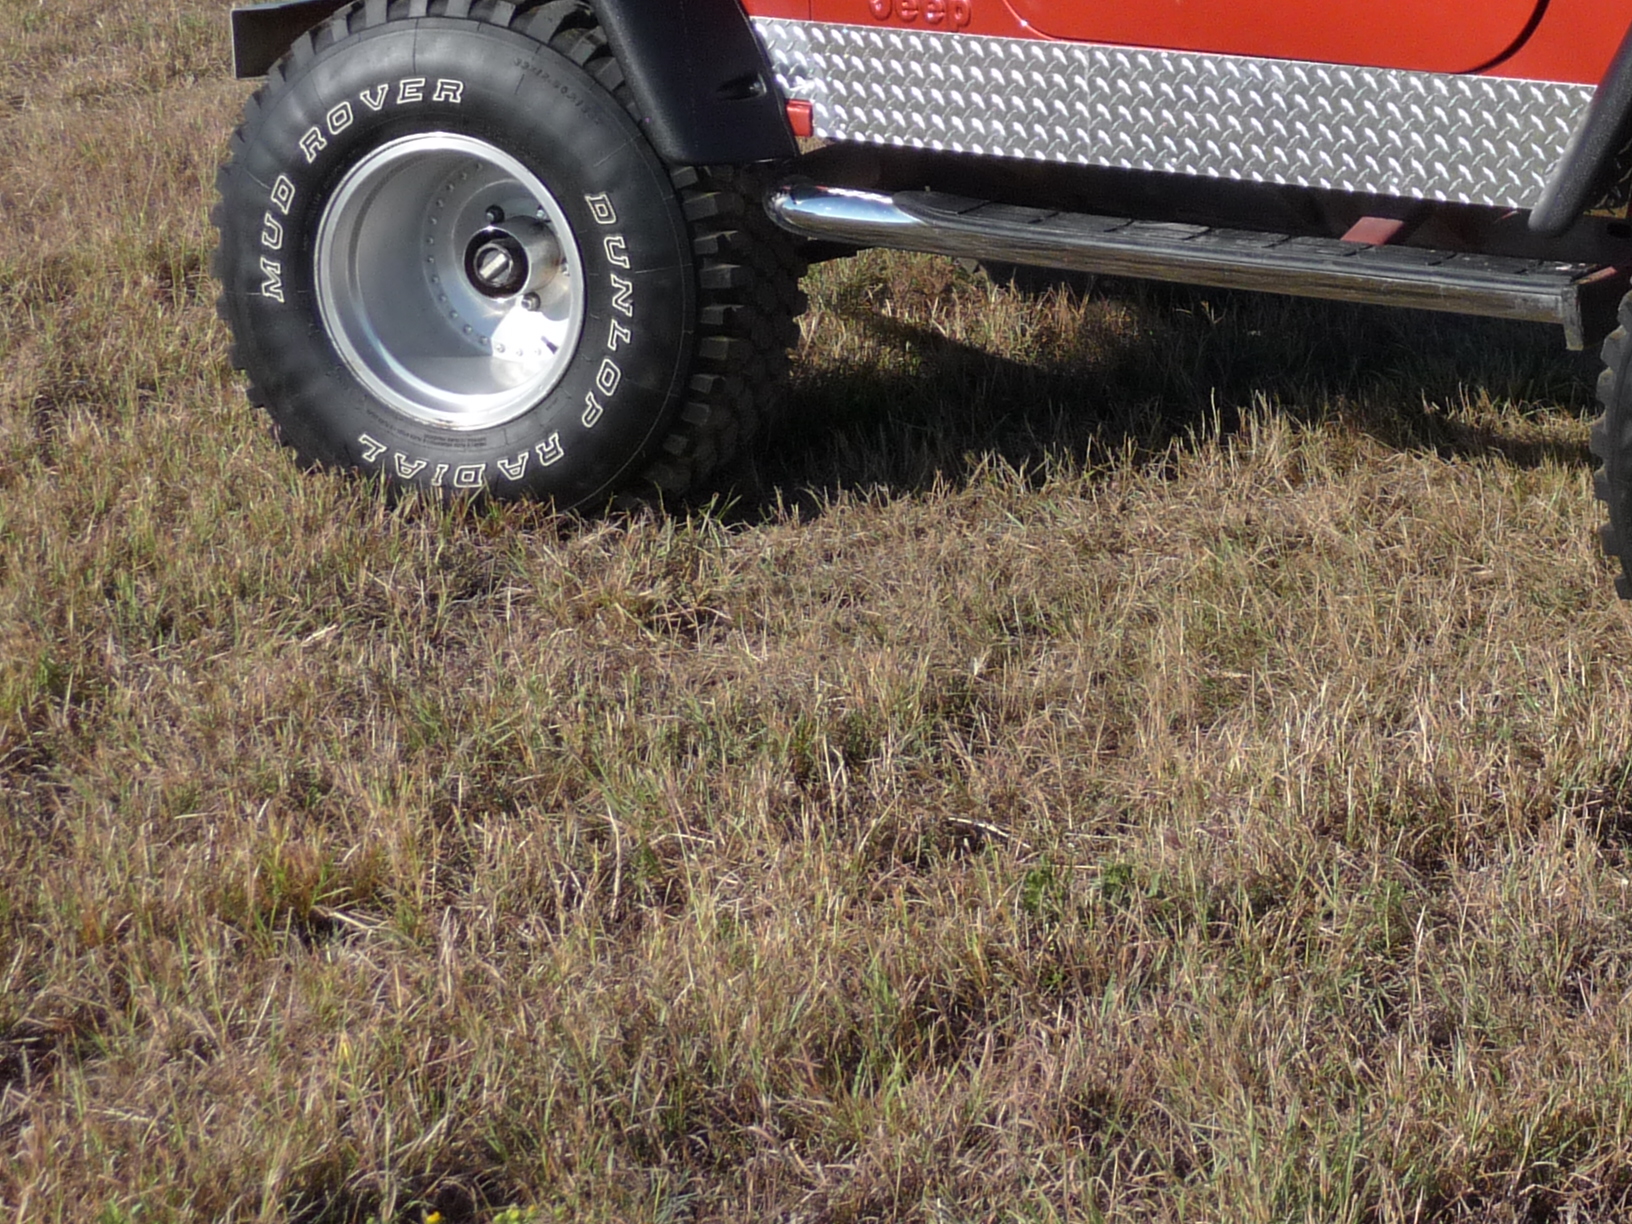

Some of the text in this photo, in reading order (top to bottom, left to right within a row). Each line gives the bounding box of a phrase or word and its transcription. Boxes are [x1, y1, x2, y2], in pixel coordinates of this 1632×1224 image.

[262, 78, 465, 304] MUD ROVER
[581, 192, 635, 430] DUNLOP
[358, 433, 565, 489] RADIAL
